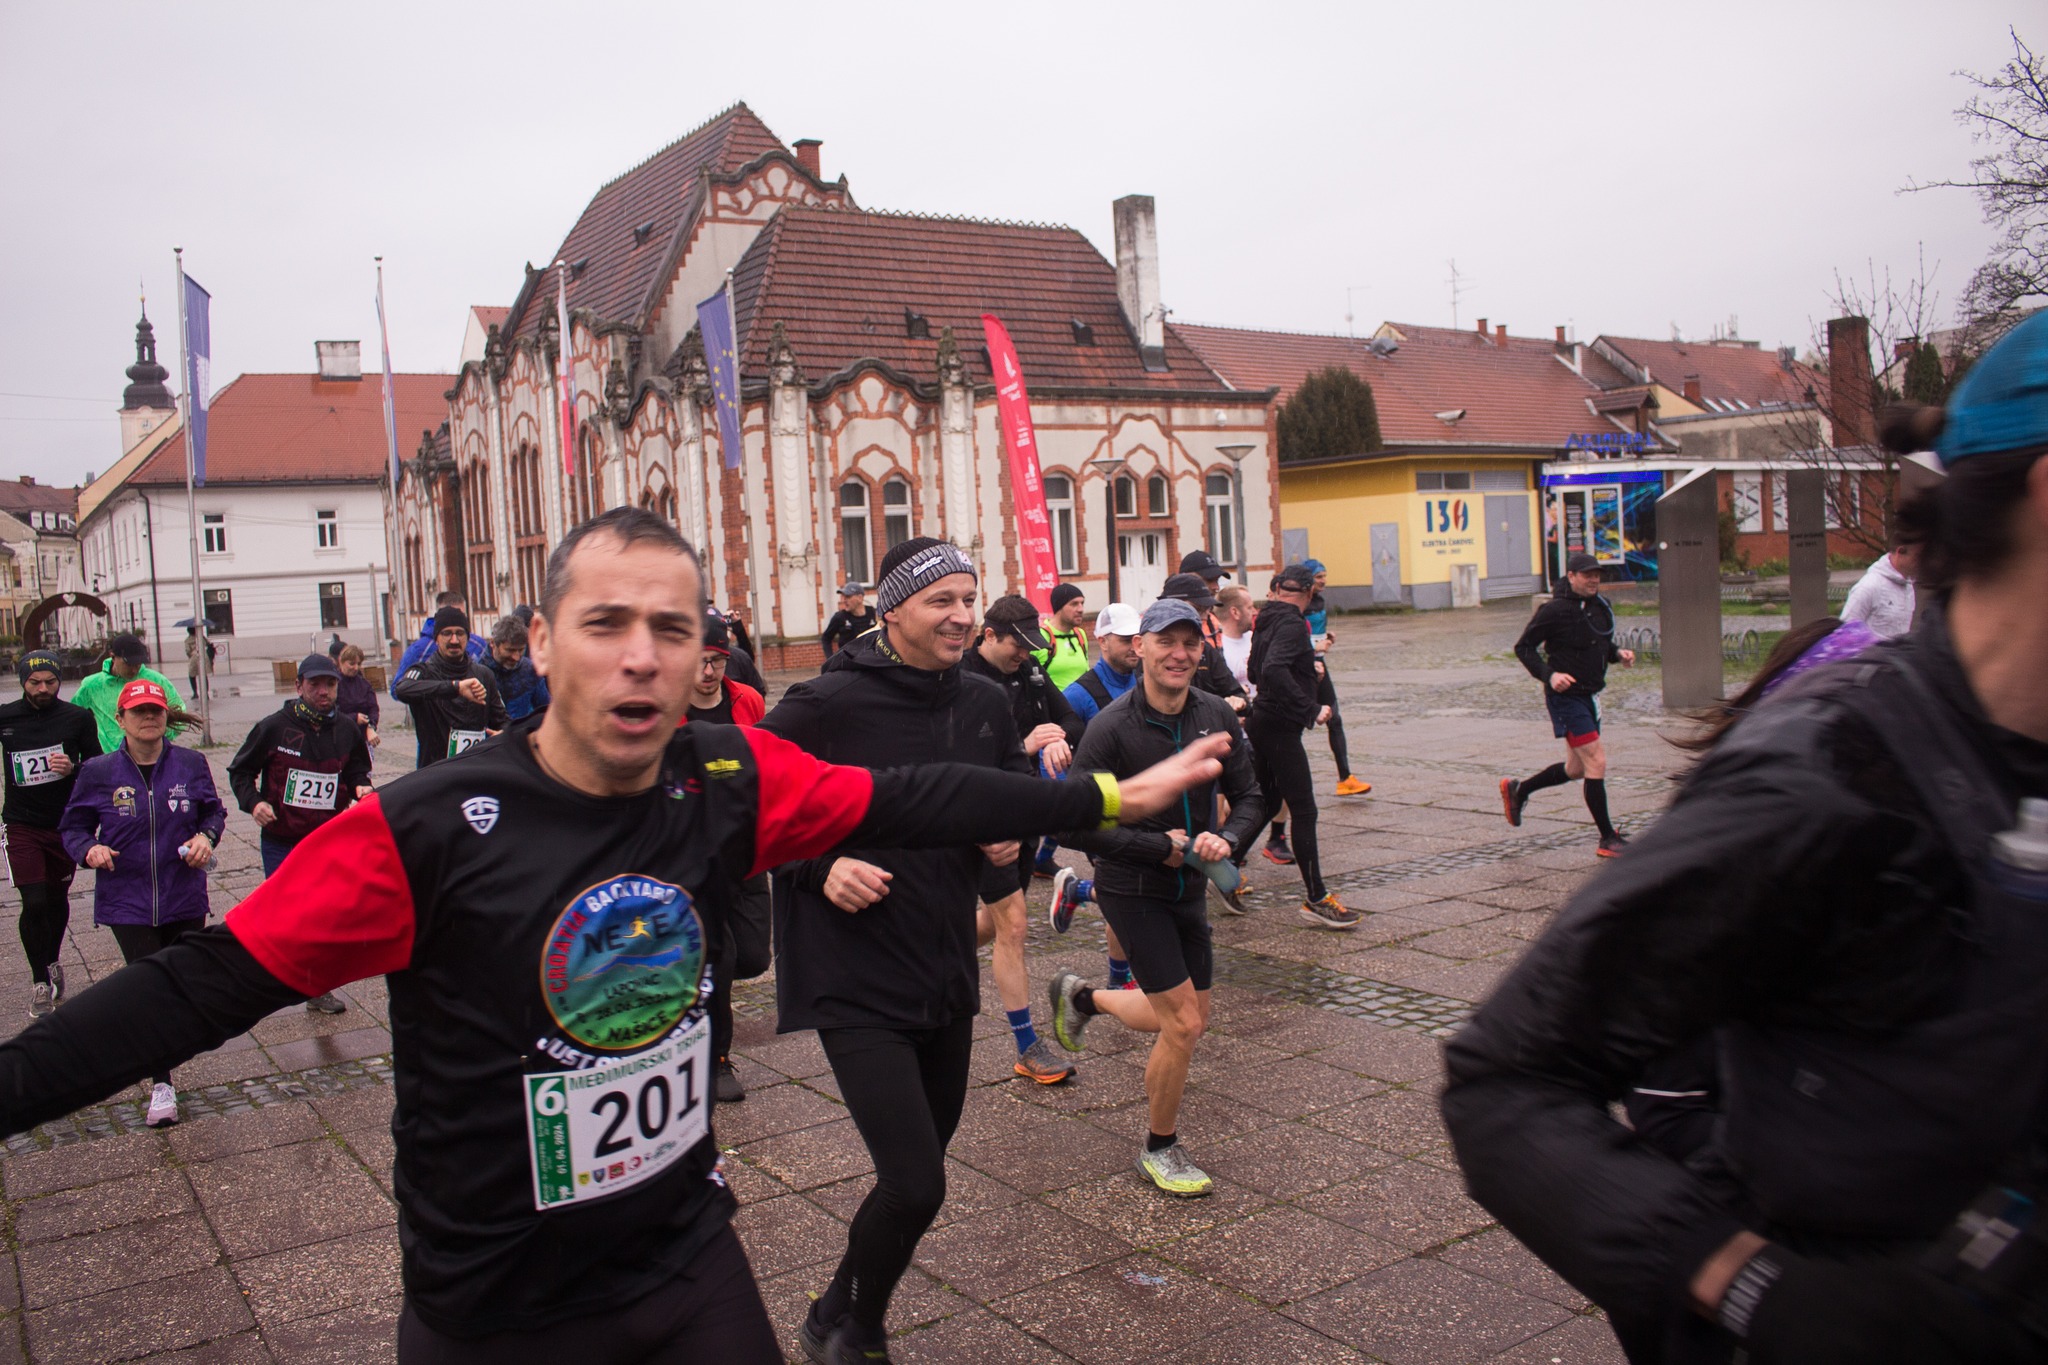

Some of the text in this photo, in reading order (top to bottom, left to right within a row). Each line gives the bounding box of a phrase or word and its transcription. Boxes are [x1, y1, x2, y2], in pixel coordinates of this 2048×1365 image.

[299, 780, 335, 799] 219
[548, 911, 588, 993] CROATIA
[585, 881, 677, 913] BACKYARD
[607, 1011, 670, 1042] NAŠICE
[537, 1037, 595, 1070] JUST
[569, 1048, 672, 1091] MEĐIMURSKI
[591, 1056, 700, 1159] 201
